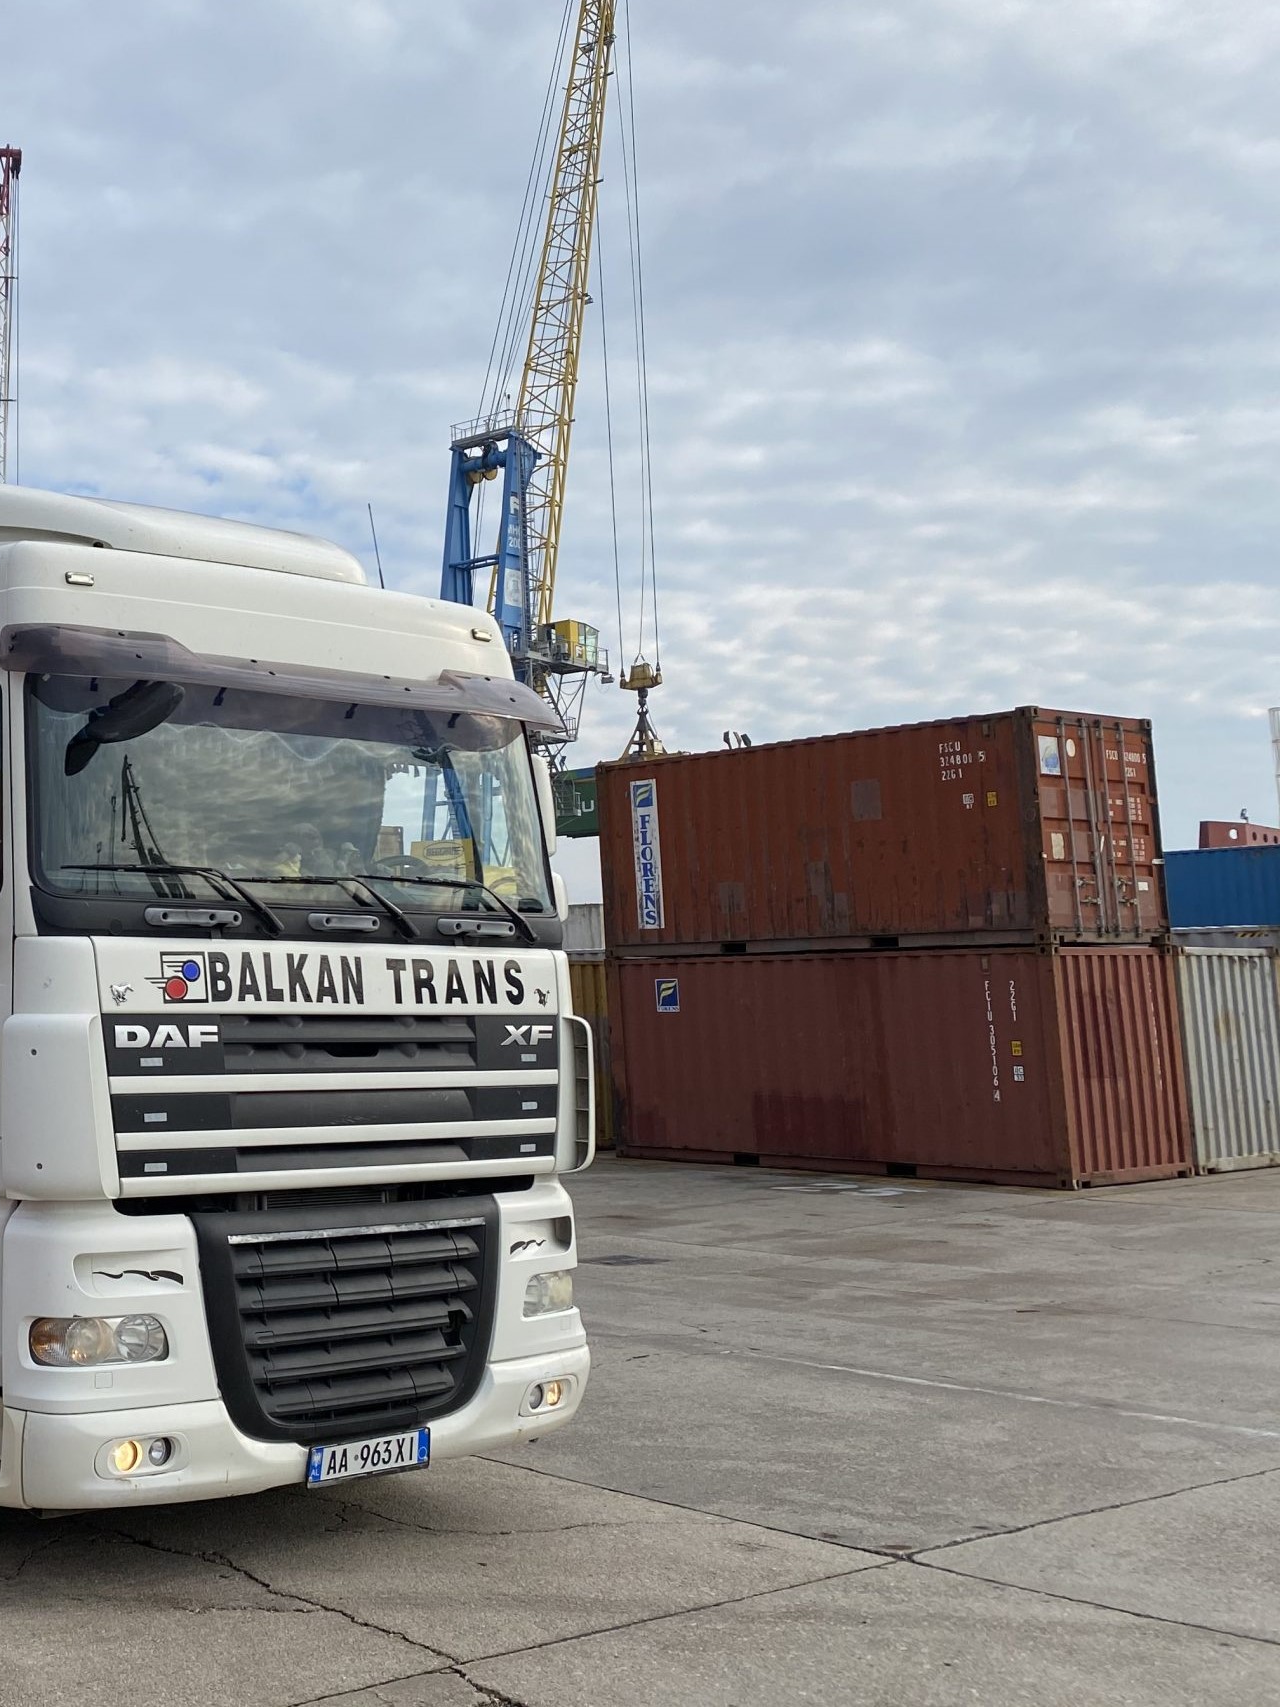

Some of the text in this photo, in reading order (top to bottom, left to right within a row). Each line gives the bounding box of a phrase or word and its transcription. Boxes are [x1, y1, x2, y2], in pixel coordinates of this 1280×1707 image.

[939, 741, 961, 753] FSCU
[978, 751, 986, 762] 5
[639, 814, 657, 926] FLORENS
[208, 952, 525, 1005] BALKAN TRANS
[114, 1024, 219, 1048] DAF
[500, 1025, 554, 1046] XF
[326, 1449, 348, 1475] AA
